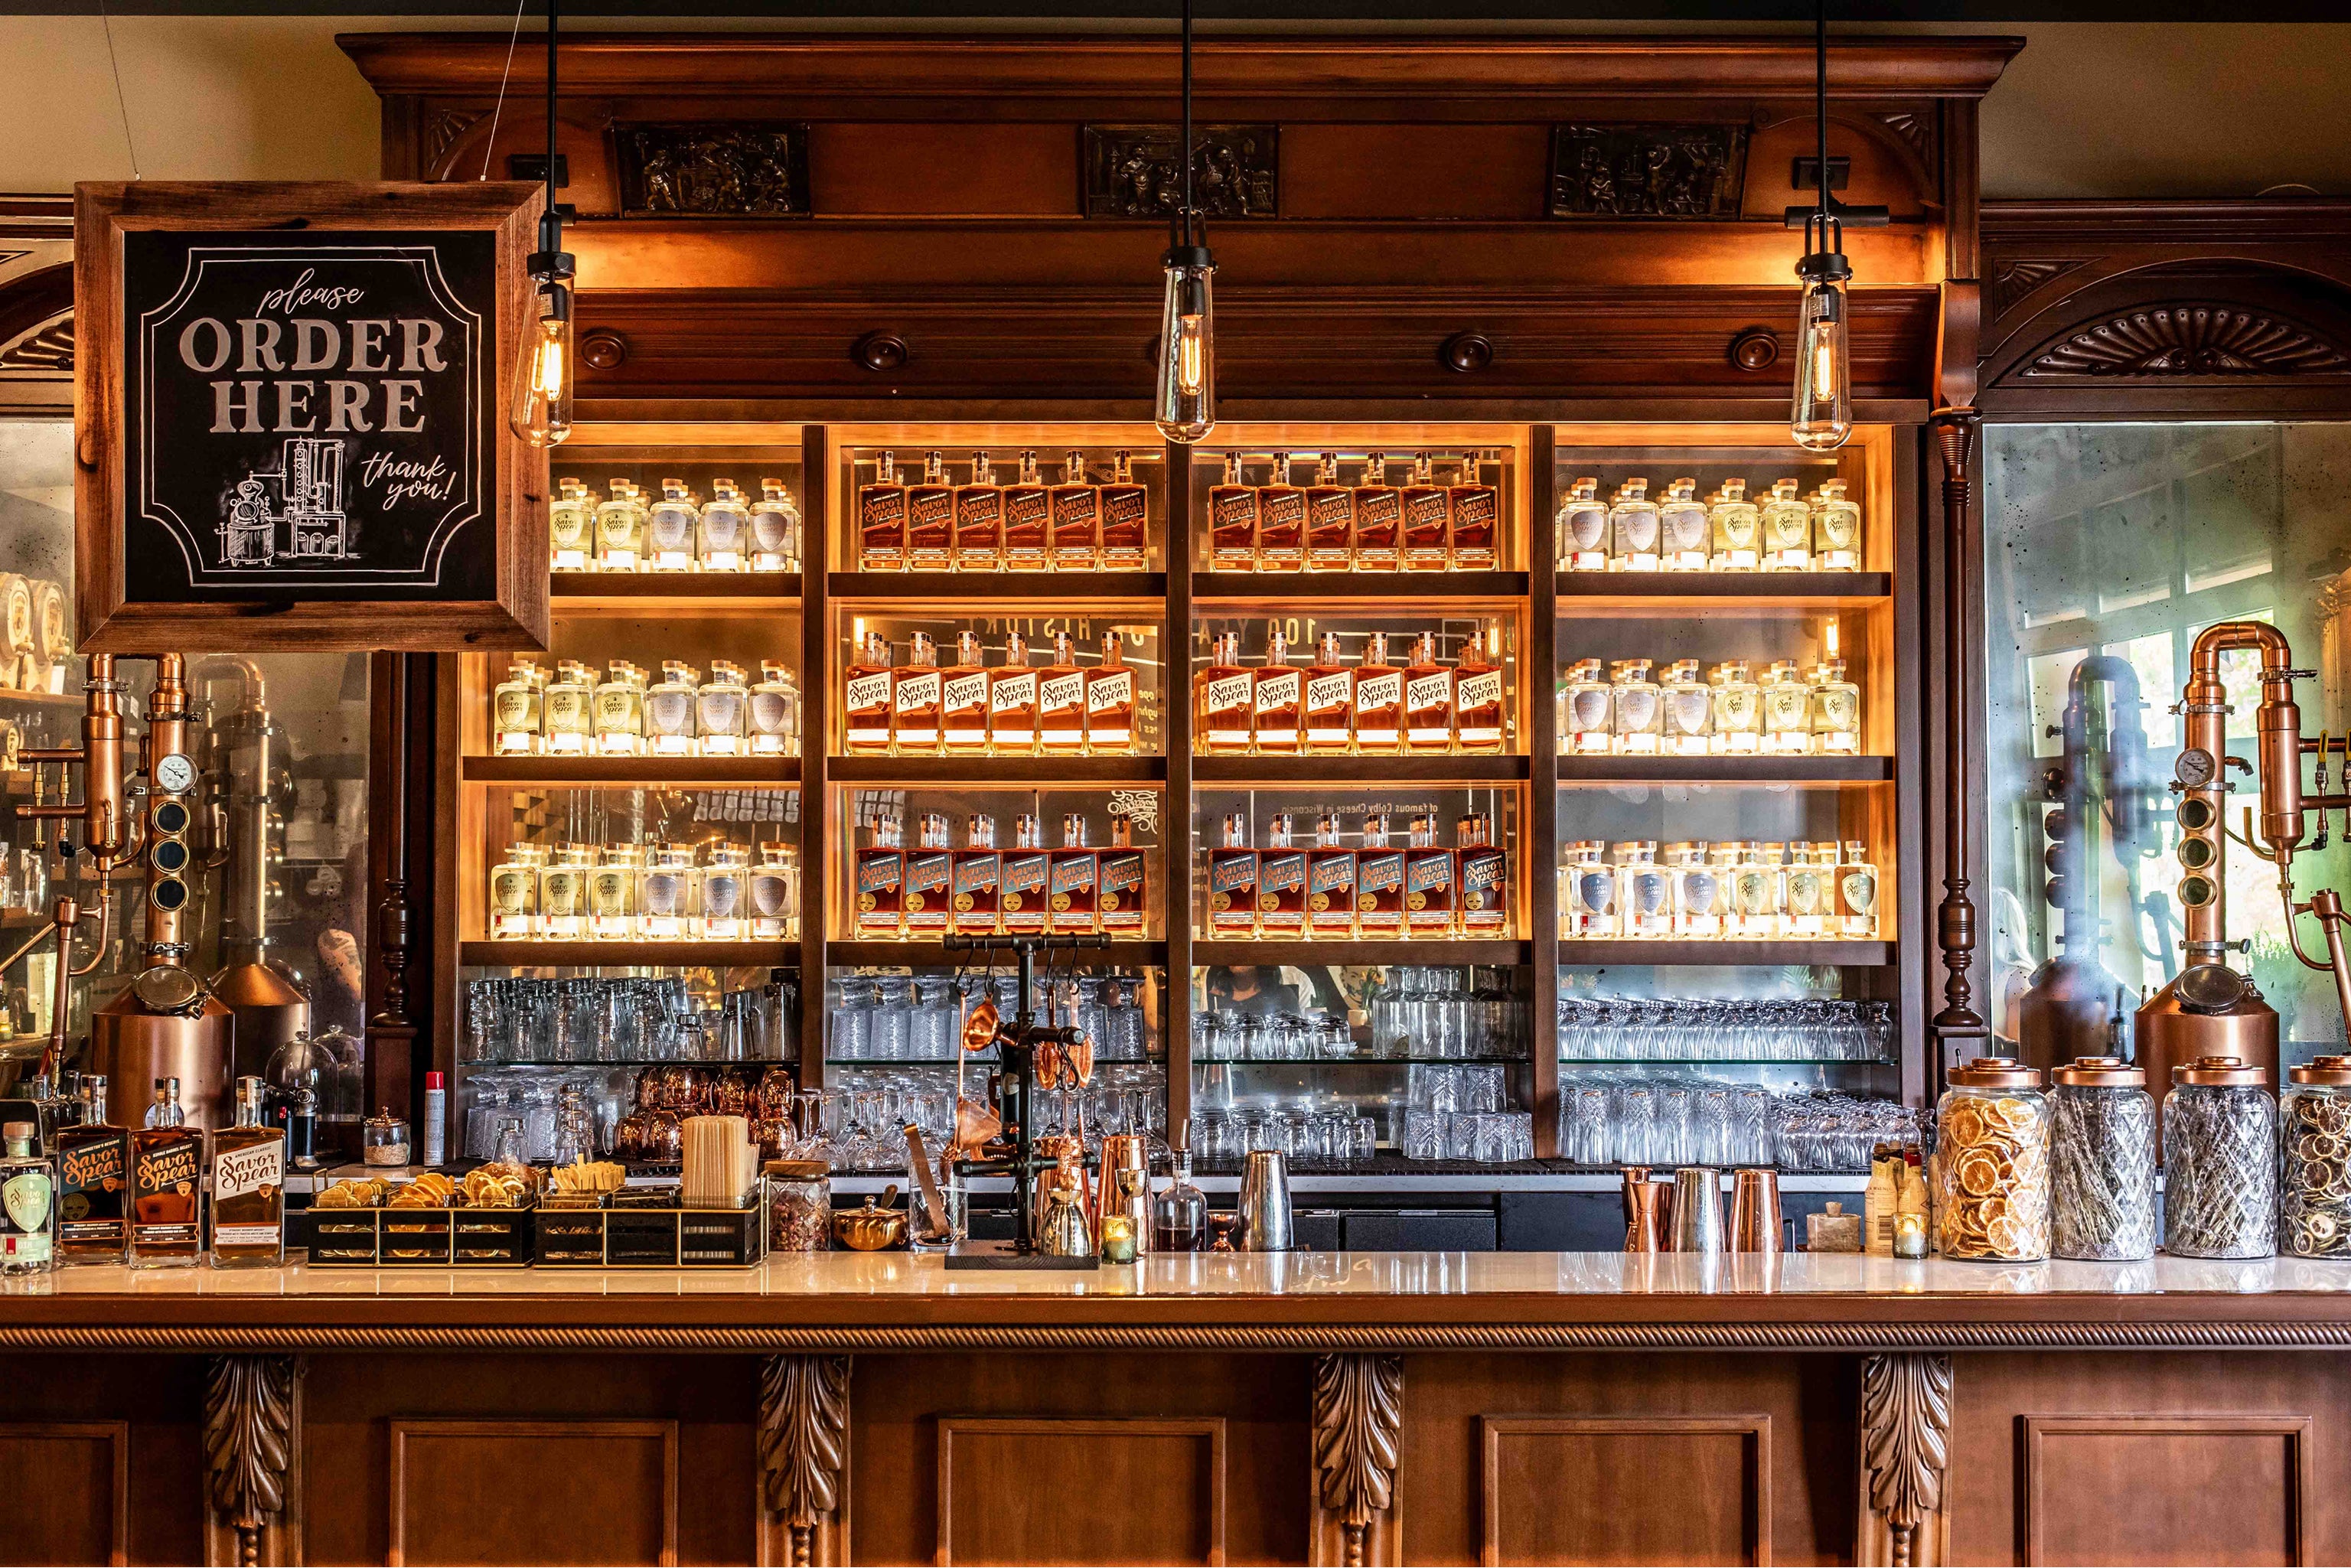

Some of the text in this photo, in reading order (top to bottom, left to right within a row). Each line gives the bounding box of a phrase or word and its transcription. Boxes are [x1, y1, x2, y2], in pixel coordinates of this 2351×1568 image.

[255, 268, 364, 318] please
[179, 318, 448, 372] ORDER
[210, 380, 425, 433] HERE
[361, 451, 446, 488] thank
[383, 471, 457, 510] you!
[849, 680, 887, 696] Savor
[898, 681, 936, 696] Savor
[946, 681, 983, 696] Savor
[994, 682, 1032, 697] Savor
[1042, 681, 1080, 696] Savor
[1091, 681, 1128, 696] Savor
[1211, 682, 1247, 697] Savor
[1258, 682, 1295, 697] Savor
[1309, 680, 1346, 696] Savor
[1311, 688, 1348, 705] Spear
[1360, 681, 1397, 696] Savor
[1409, 681, 1446, 696] Savor
[1461, 680, 1498, 696] Savor
[1462, 688, 1499, 705] Spear
[851, 689, 888, 706] Spear
[900, 689, 937, 706] Spear
[947, 689, 984, 706] Spear
[996, 690, 1032, 707] Spear
[1044, 689, 1081, 706] Spear
[1092, 689, 1129, 706] Spear
[1212, 689, 1249, 706] Spear
[1260, 689, 1296, 706] Spear
[1361, 689, 1398, 706] Spear
[1410, 689, 1447, 706] Spear
[63, 1147, 119, 1173] Savor
[235, 1150, 255, 1159] AMERICAN
[137, 1151, 195, 1177] Savor
[220, 1153, 276, 1177] Savor
[65, 1159, 122, 1187] Spear
[139, 1163, 198, 1191] Spear
[221, 1165, 279, 1191] Spear
